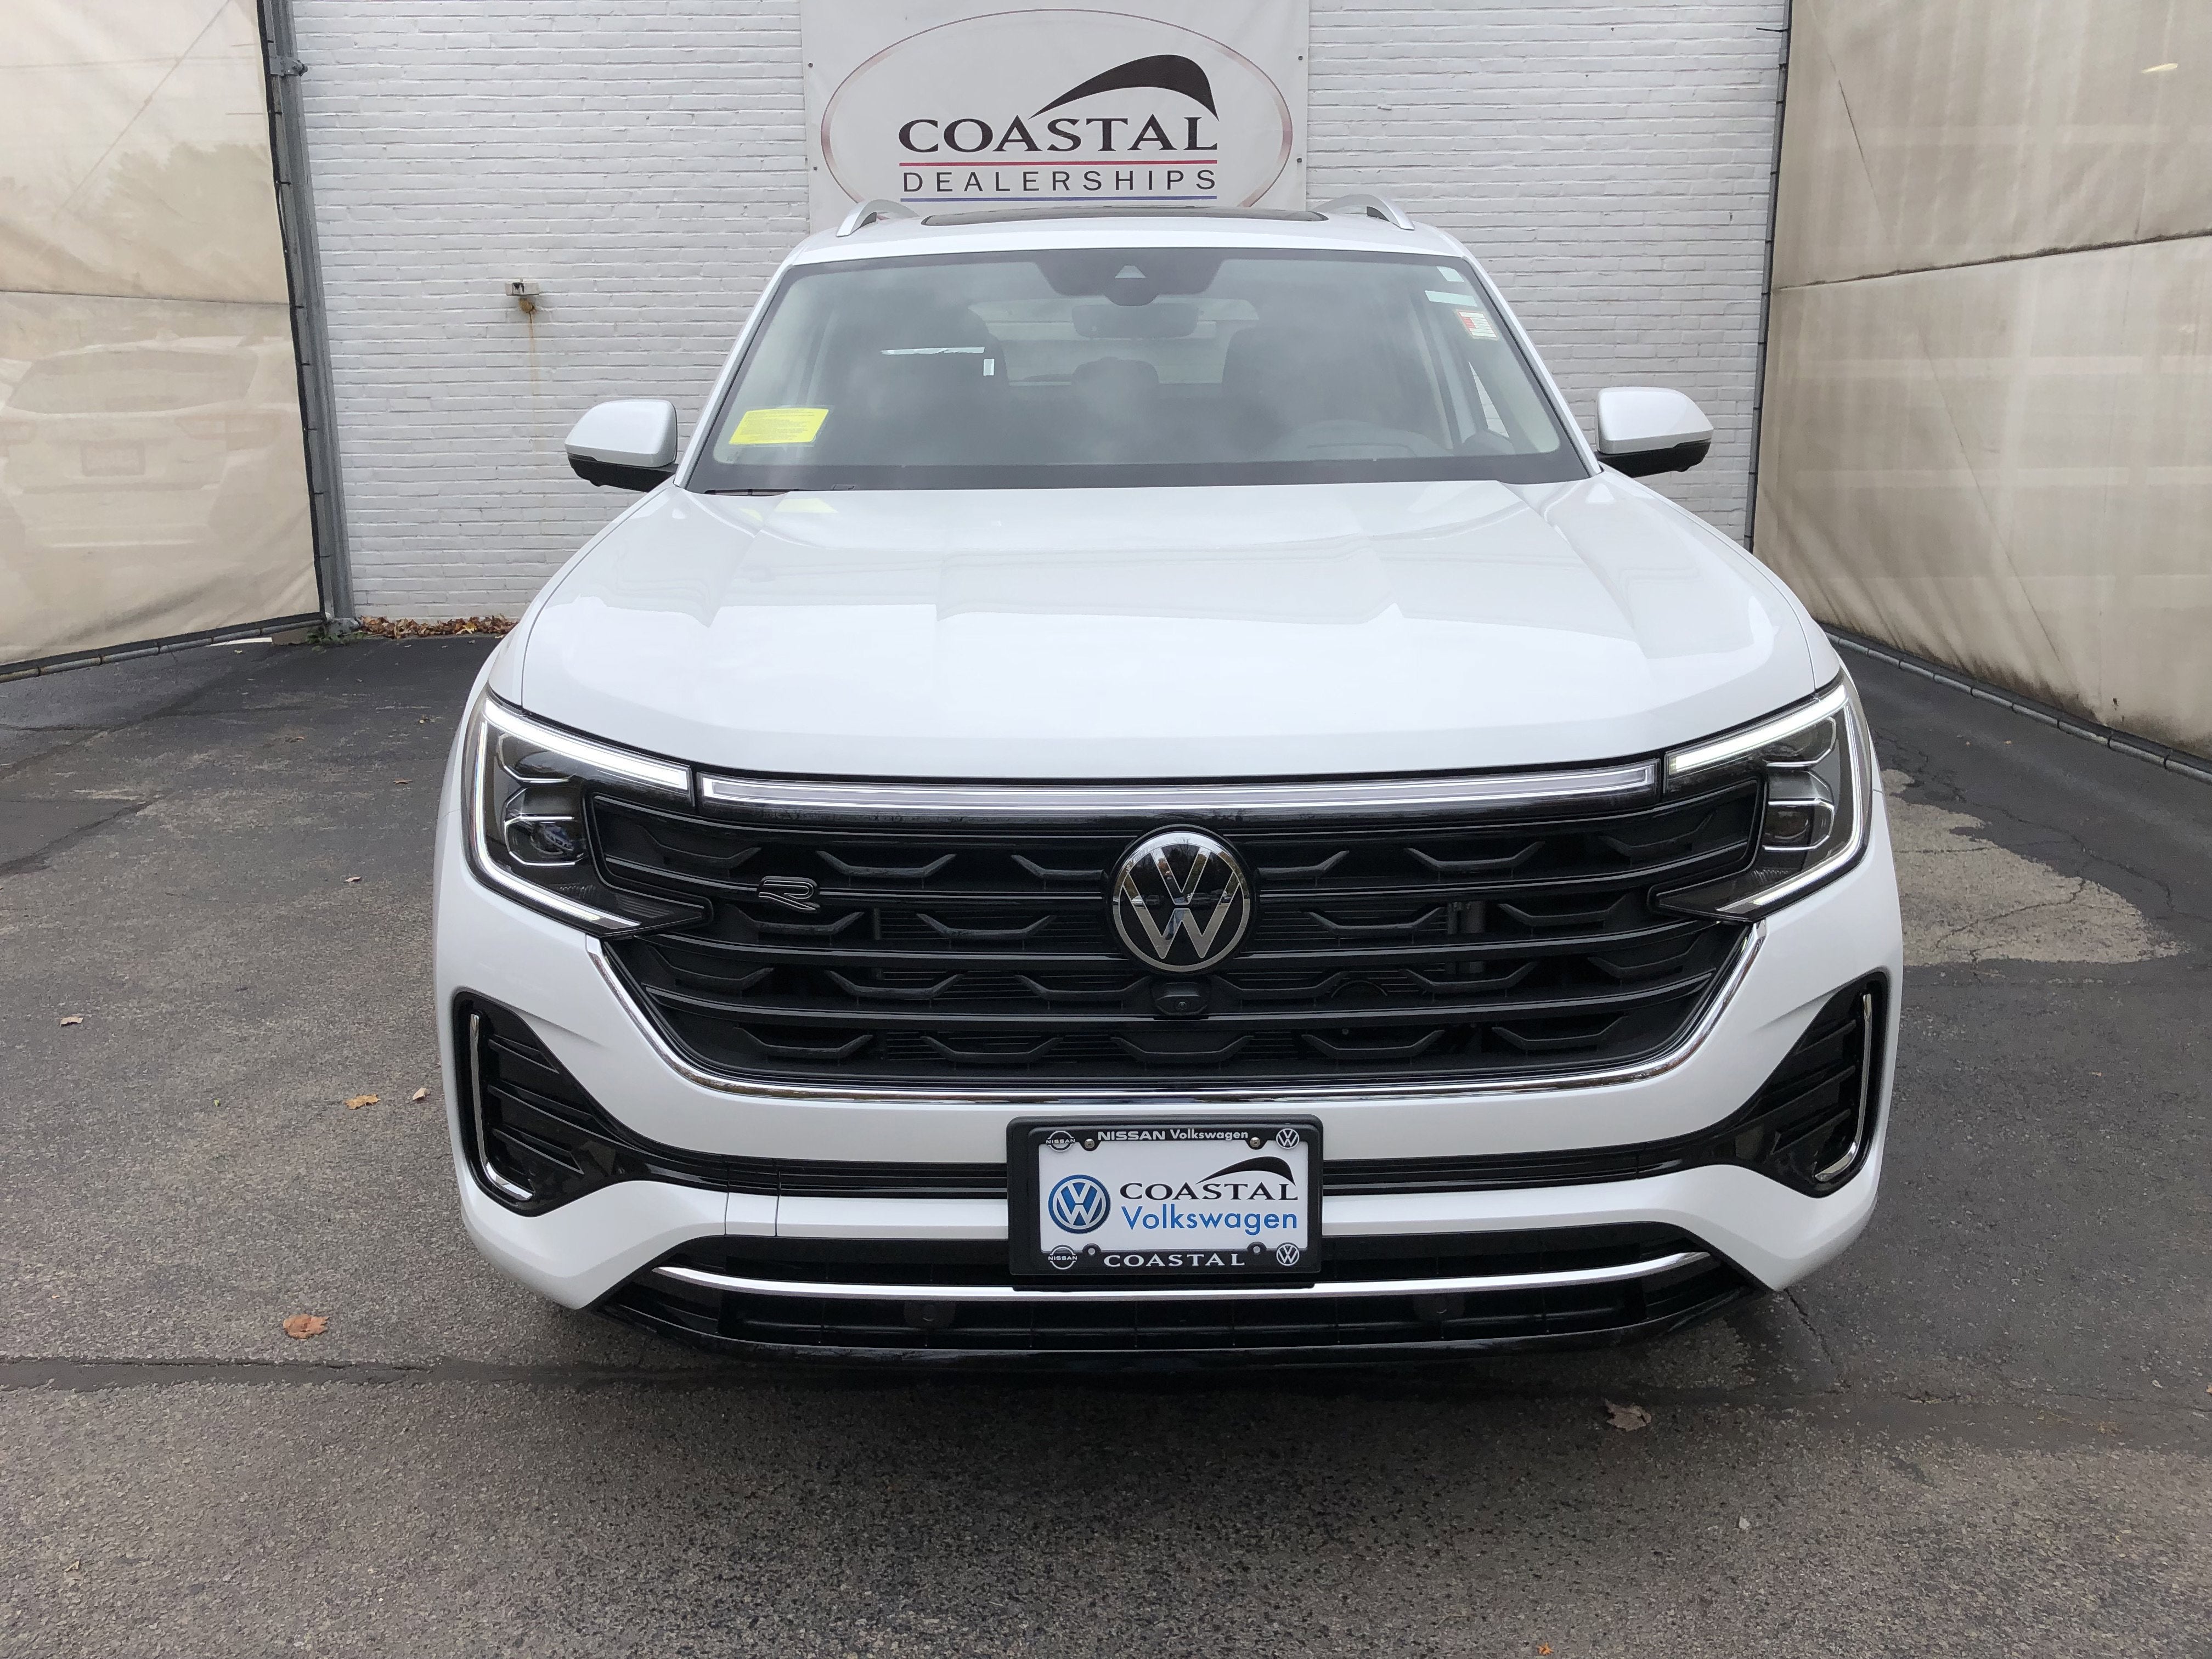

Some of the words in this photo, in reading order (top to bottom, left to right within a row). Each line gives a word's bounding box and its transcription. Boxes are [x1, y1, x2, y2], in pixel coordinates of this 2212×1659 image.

[898, 115, 1218, 153] COASTAL
[904, 169, 1216, 193] DEALERSHIPS
[1098, 1131, 1165, 1141] NISSAN
[1170, 1128, 1248, 1142] Volkswagen
[1120, 1182, 1298, 1201] COASTAL
[1121, 1203, 1298, 1236] Volkswagen
[1103, 1252, 1245, 1267] COASTAL
